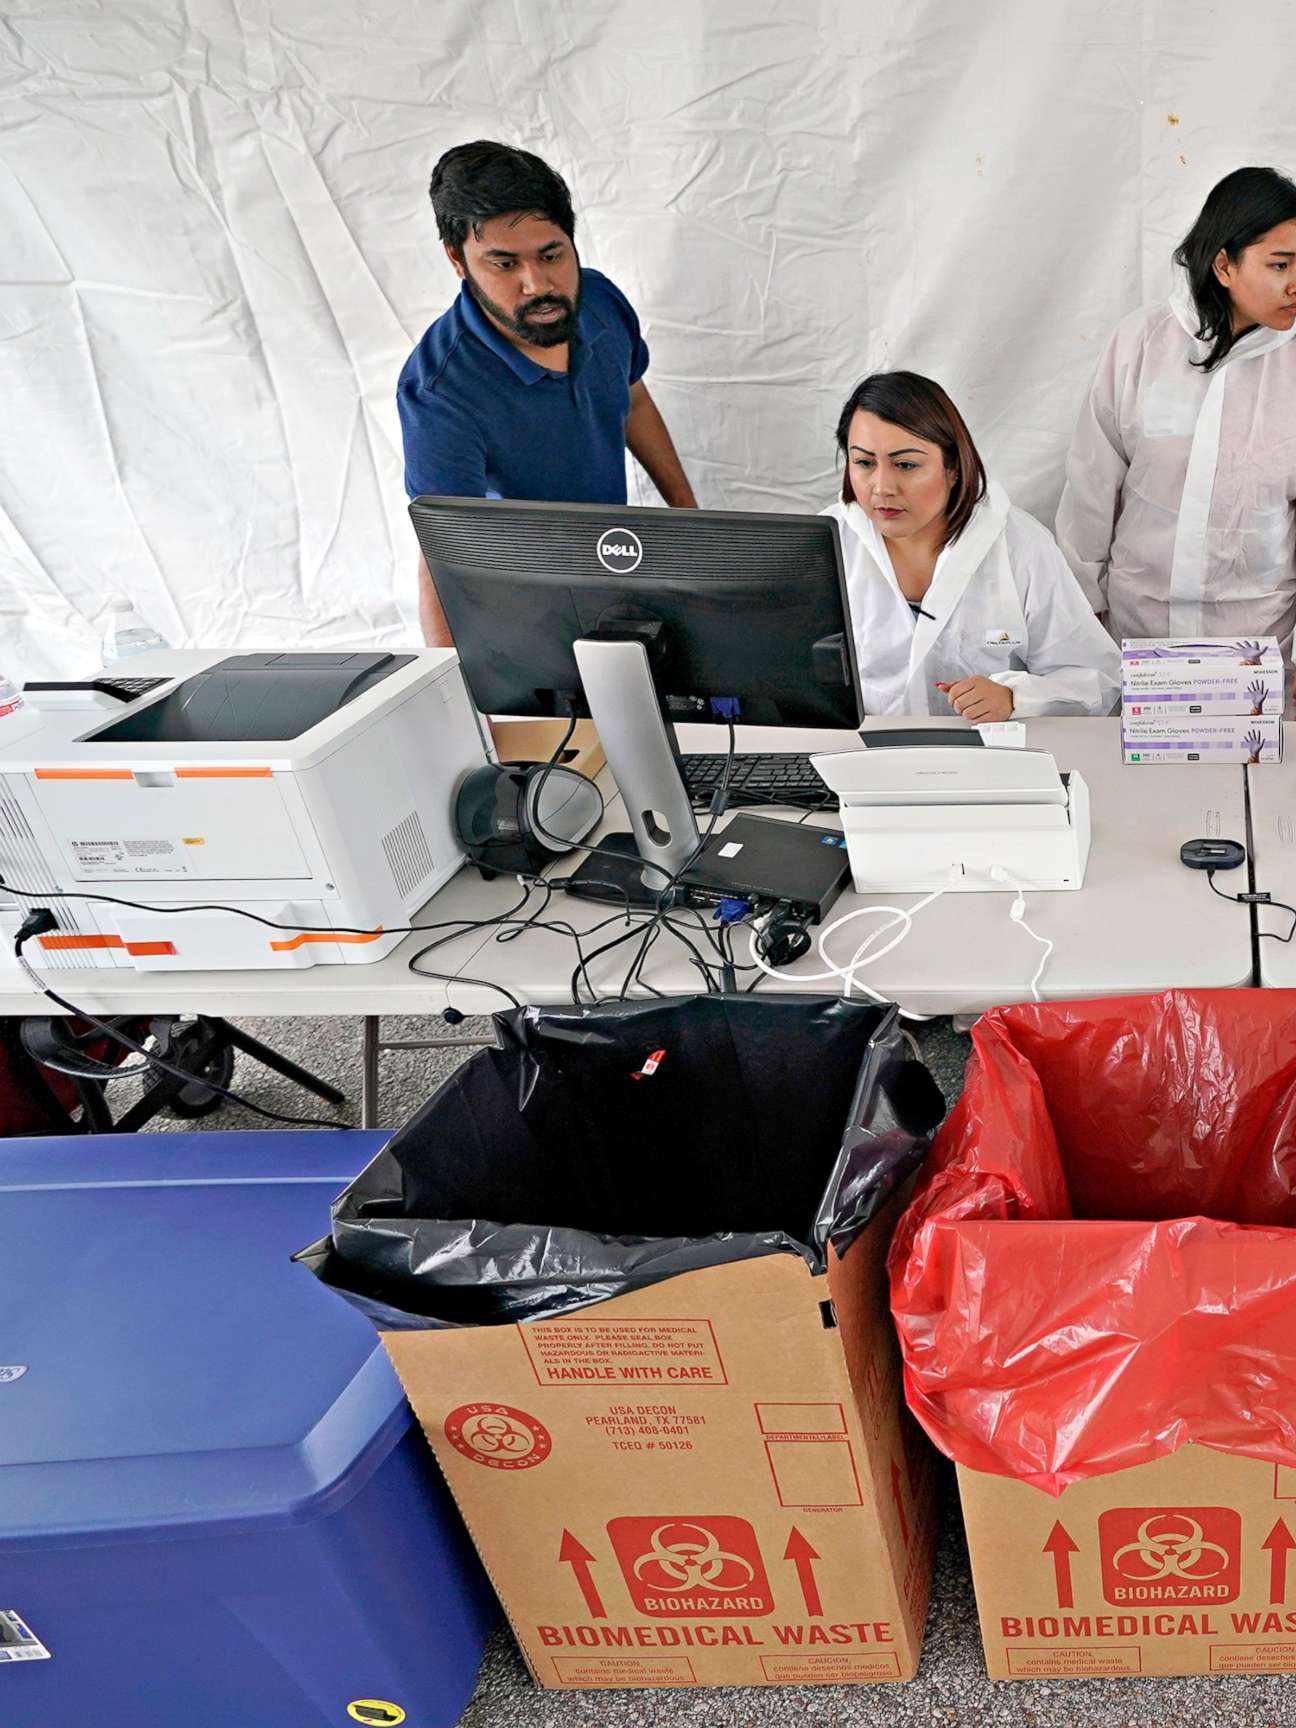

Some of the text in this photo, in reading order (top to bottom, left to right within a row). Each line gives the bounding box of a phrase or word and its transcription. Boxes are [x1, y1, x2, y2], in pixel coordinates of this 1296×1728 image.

[602, 544, 638, 556] DELL
[547, 1367, 713, 1379] HANDLE WITH CARE
[466, 1406, 509, 1414] USA
[609, 1406, 677, 1414] USA DECON
[654, 1416, 670, 1424] TX
[673, 1416, 706, 1424] 77581
[605, 1426, 635, 1436] (713)
[646, 1441, 656, 1449] #
[658, 1441, 693, 1449] 50126
[472, 1454, 543, 1468] DECON
[1114, 1585, 1230, 1600] BIOHAZARD
[644, 1597, 764, 1610] BIOHAZARD
[1000, 1615, 1219, 1637] BIOMEDICAL
[537, 1622, 894, 1646] BIOMEDICAL WASTE
